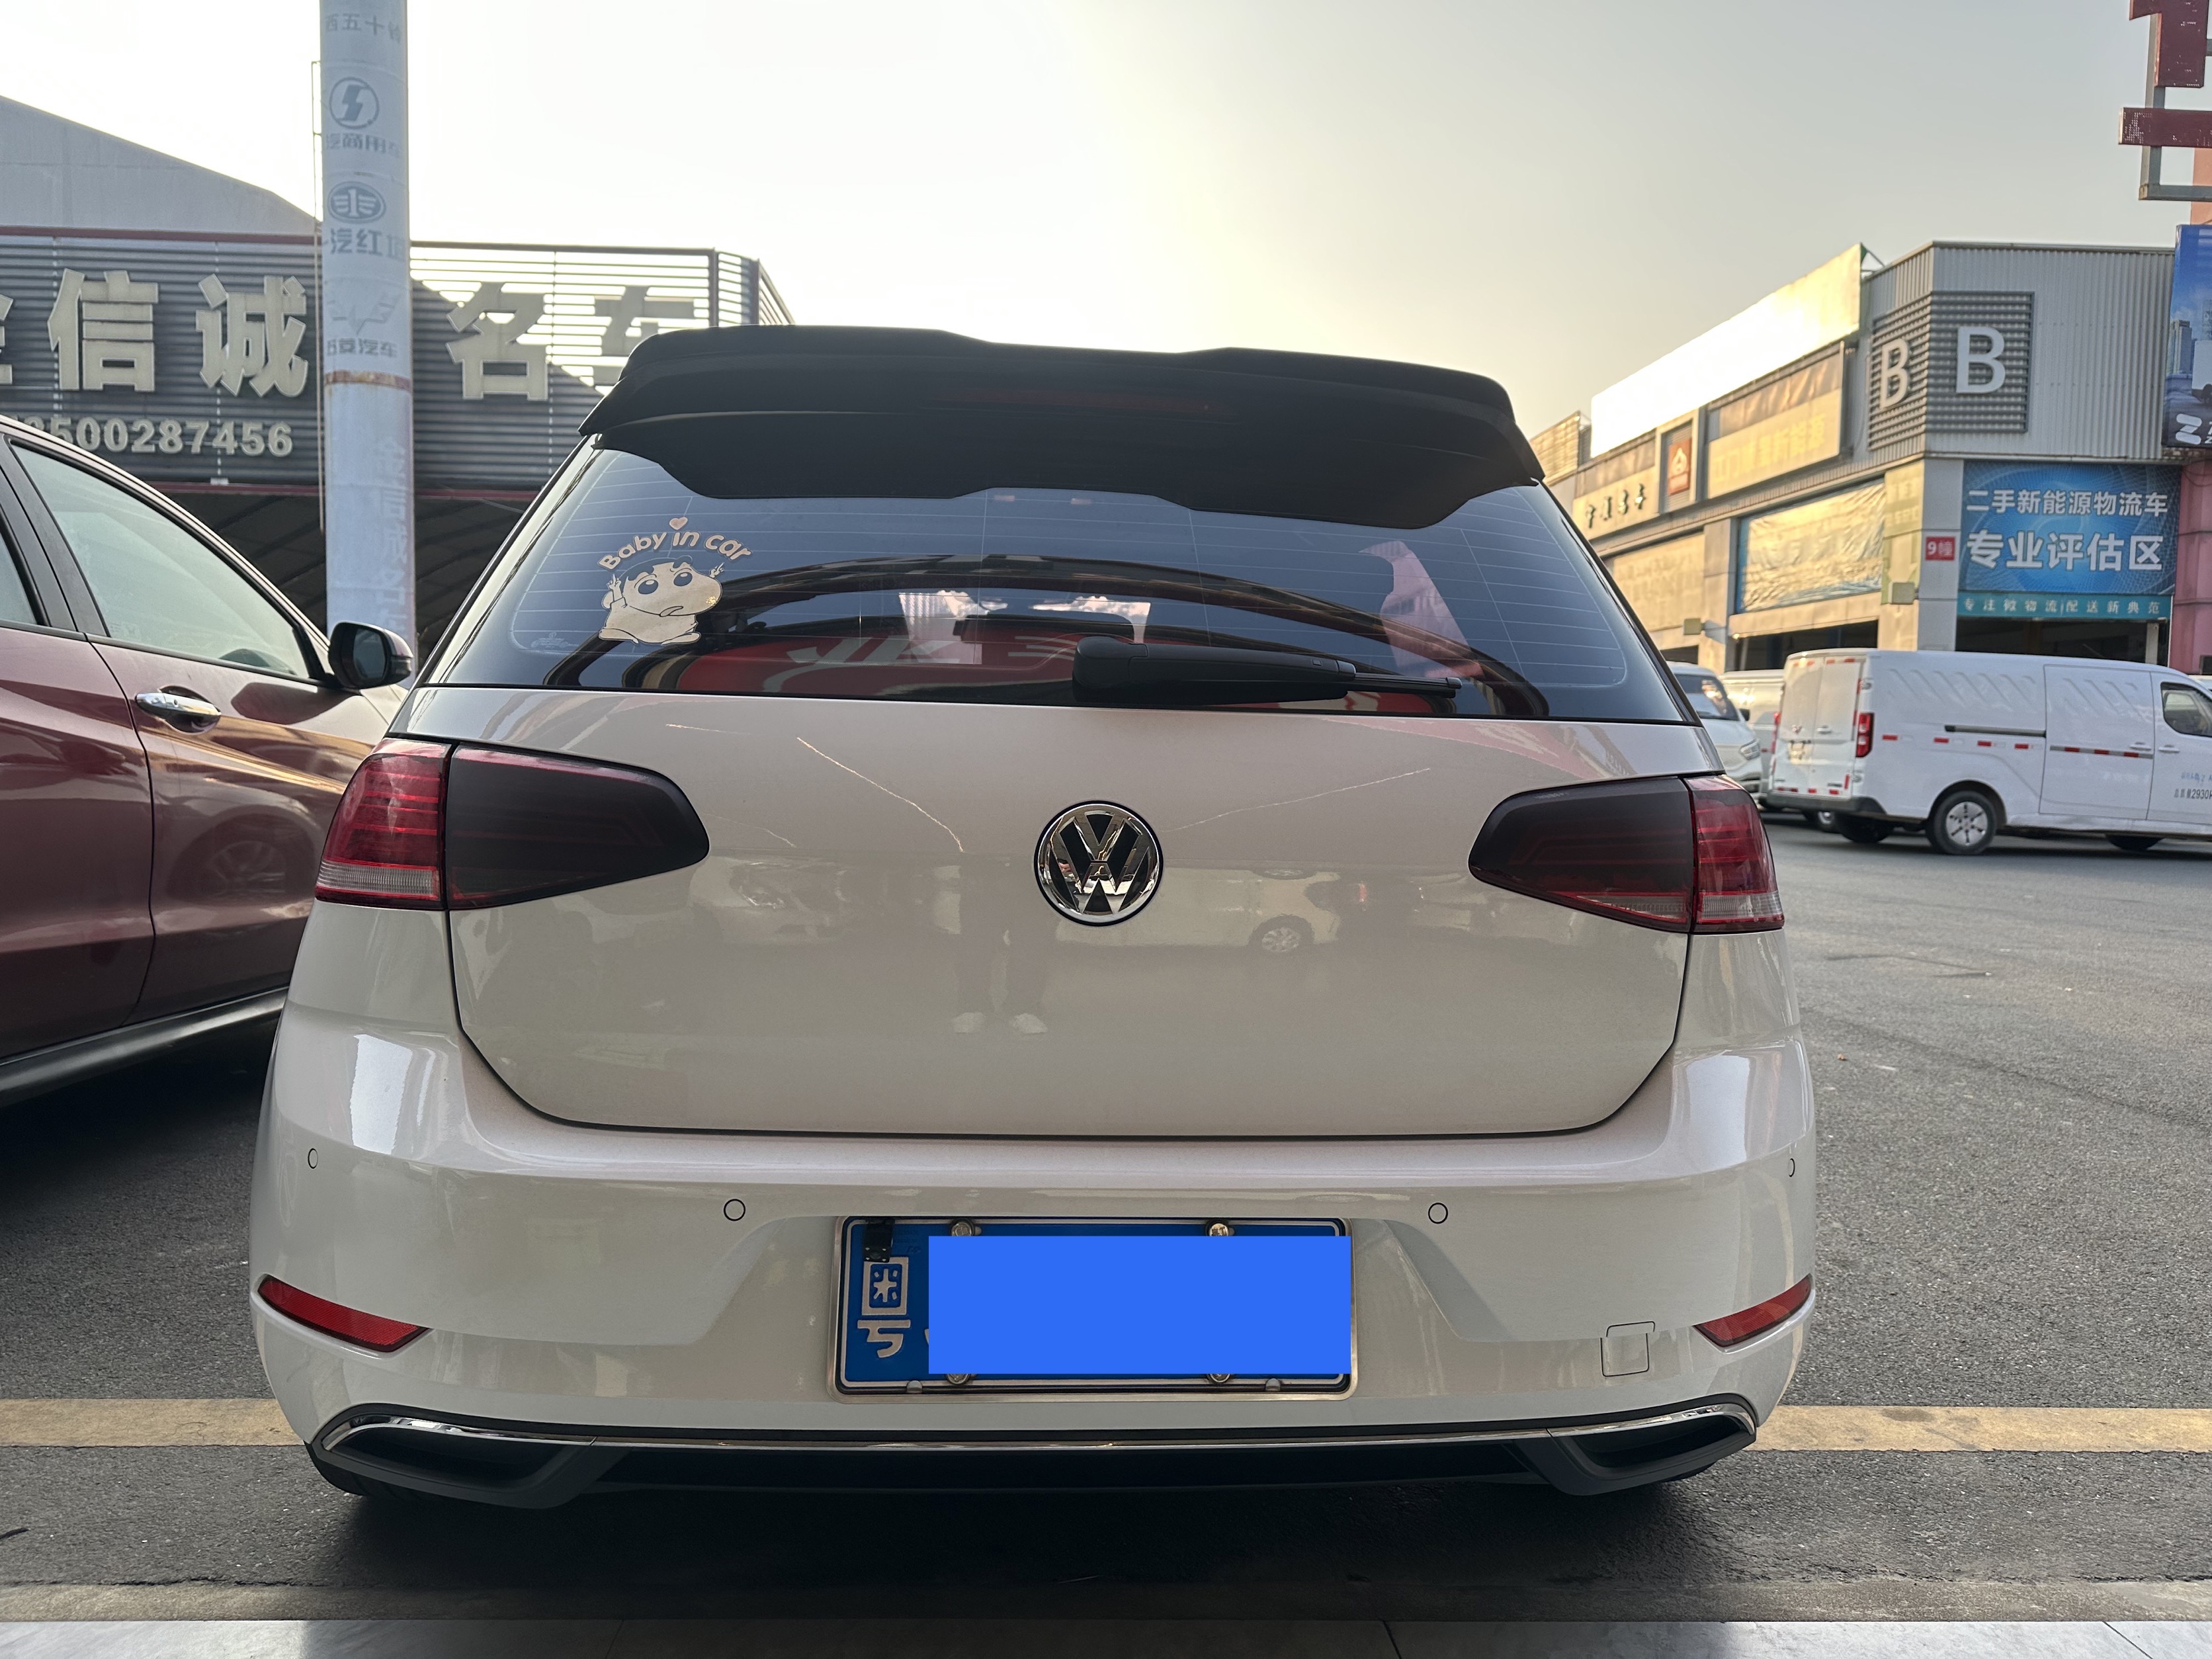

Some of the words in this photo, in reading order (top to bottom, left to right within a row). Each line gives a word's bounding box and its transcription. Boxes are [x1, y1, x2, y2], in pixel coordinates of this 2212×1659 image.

[1879, 338, 1909, 411] B
[1956, 325, 2006, 394] B
[9, 414, 293, 457] 500287456
[1966, 489, 2168, 517] 二手新能源物流车
[598, 532, 667, 570] Baby
[671, 527, 701, 547] in
[704, 534, 753, 561] car
[1966, 530, 2164, 572] 专业评估区
